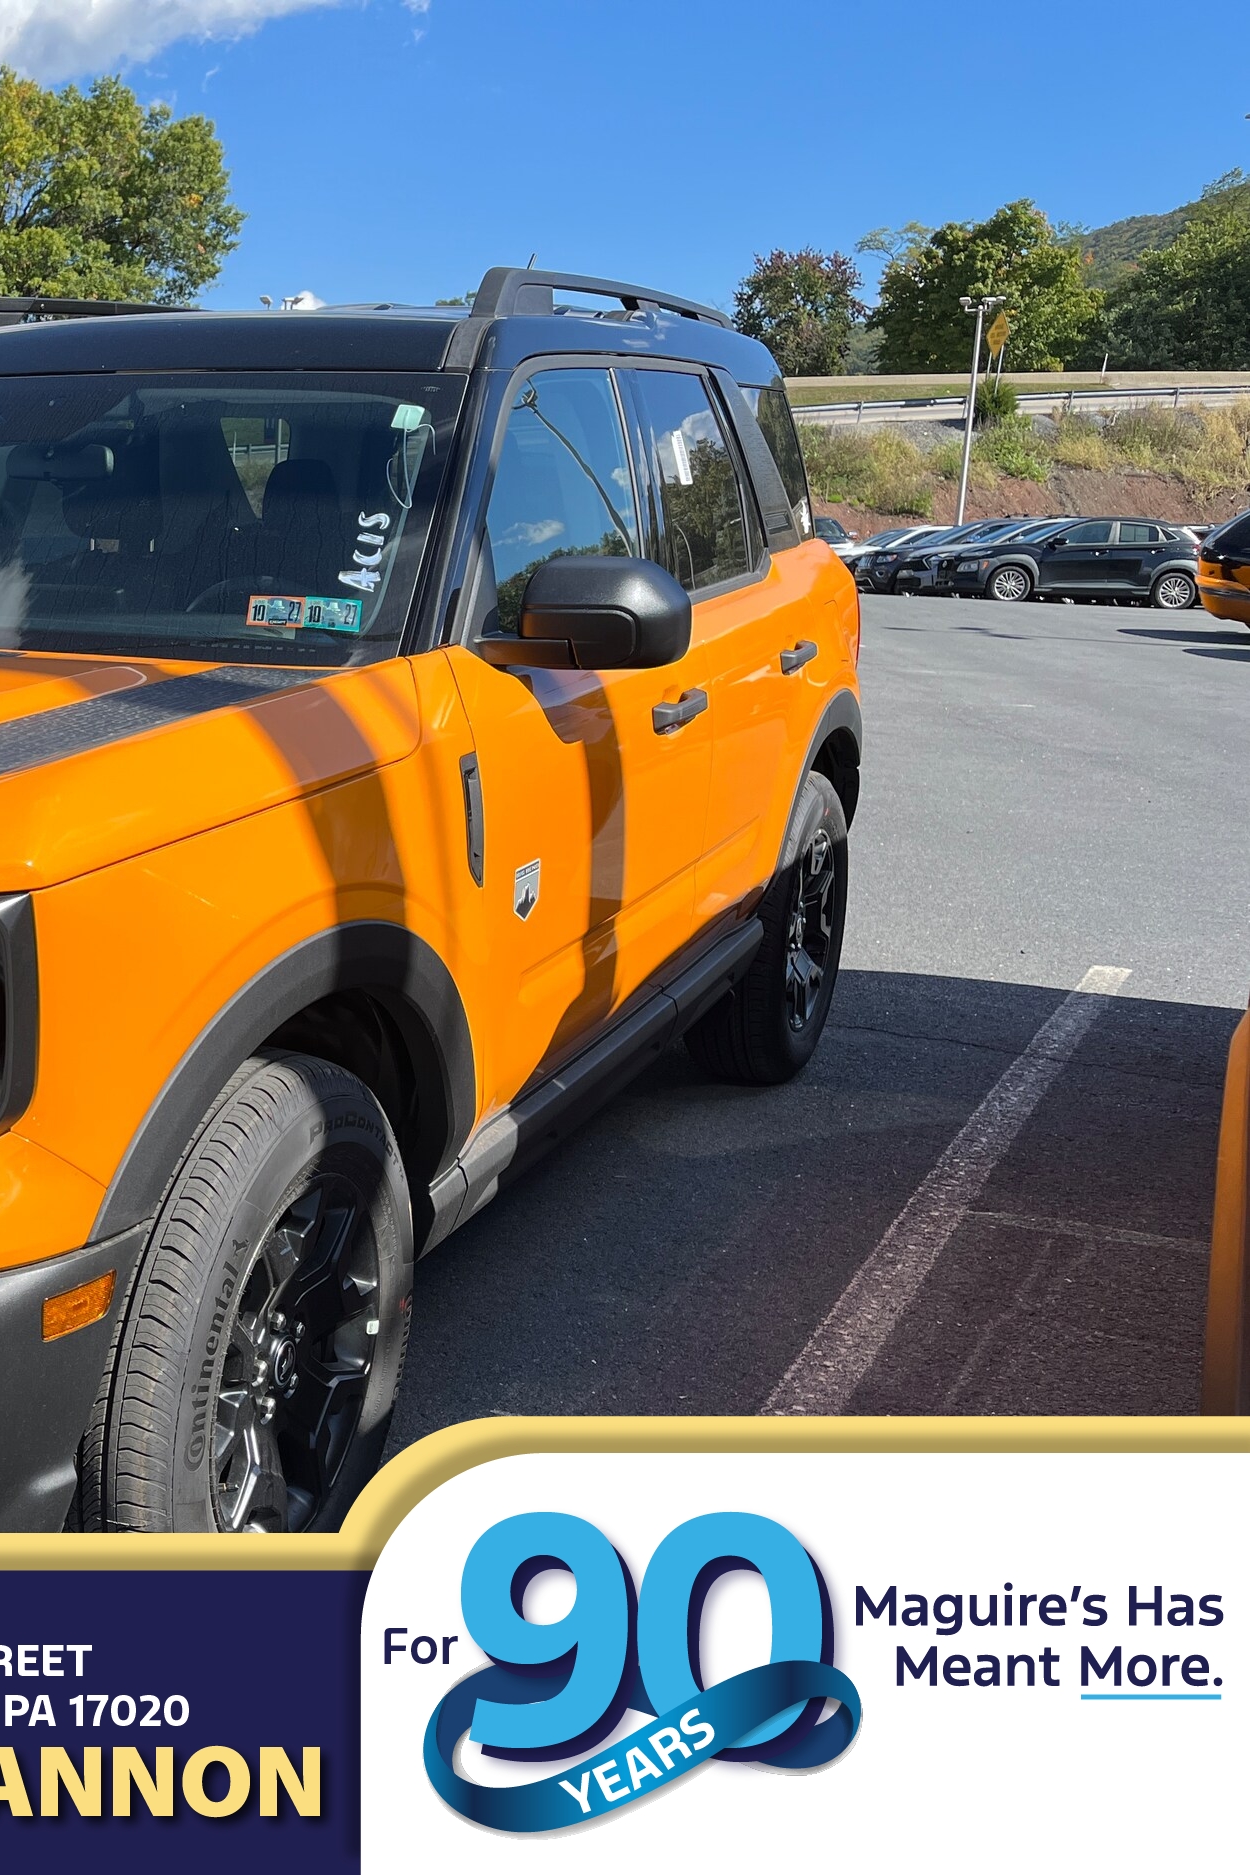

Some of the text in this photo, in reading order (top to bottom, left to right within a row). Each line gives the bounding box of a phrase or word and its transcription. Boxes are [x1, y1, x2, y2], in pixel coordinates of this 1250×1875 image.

[252, 601, 302, 624] 10 27
[307, 603, 358, 626] 10 27
[183, 1260, 240, 1473] Continental
